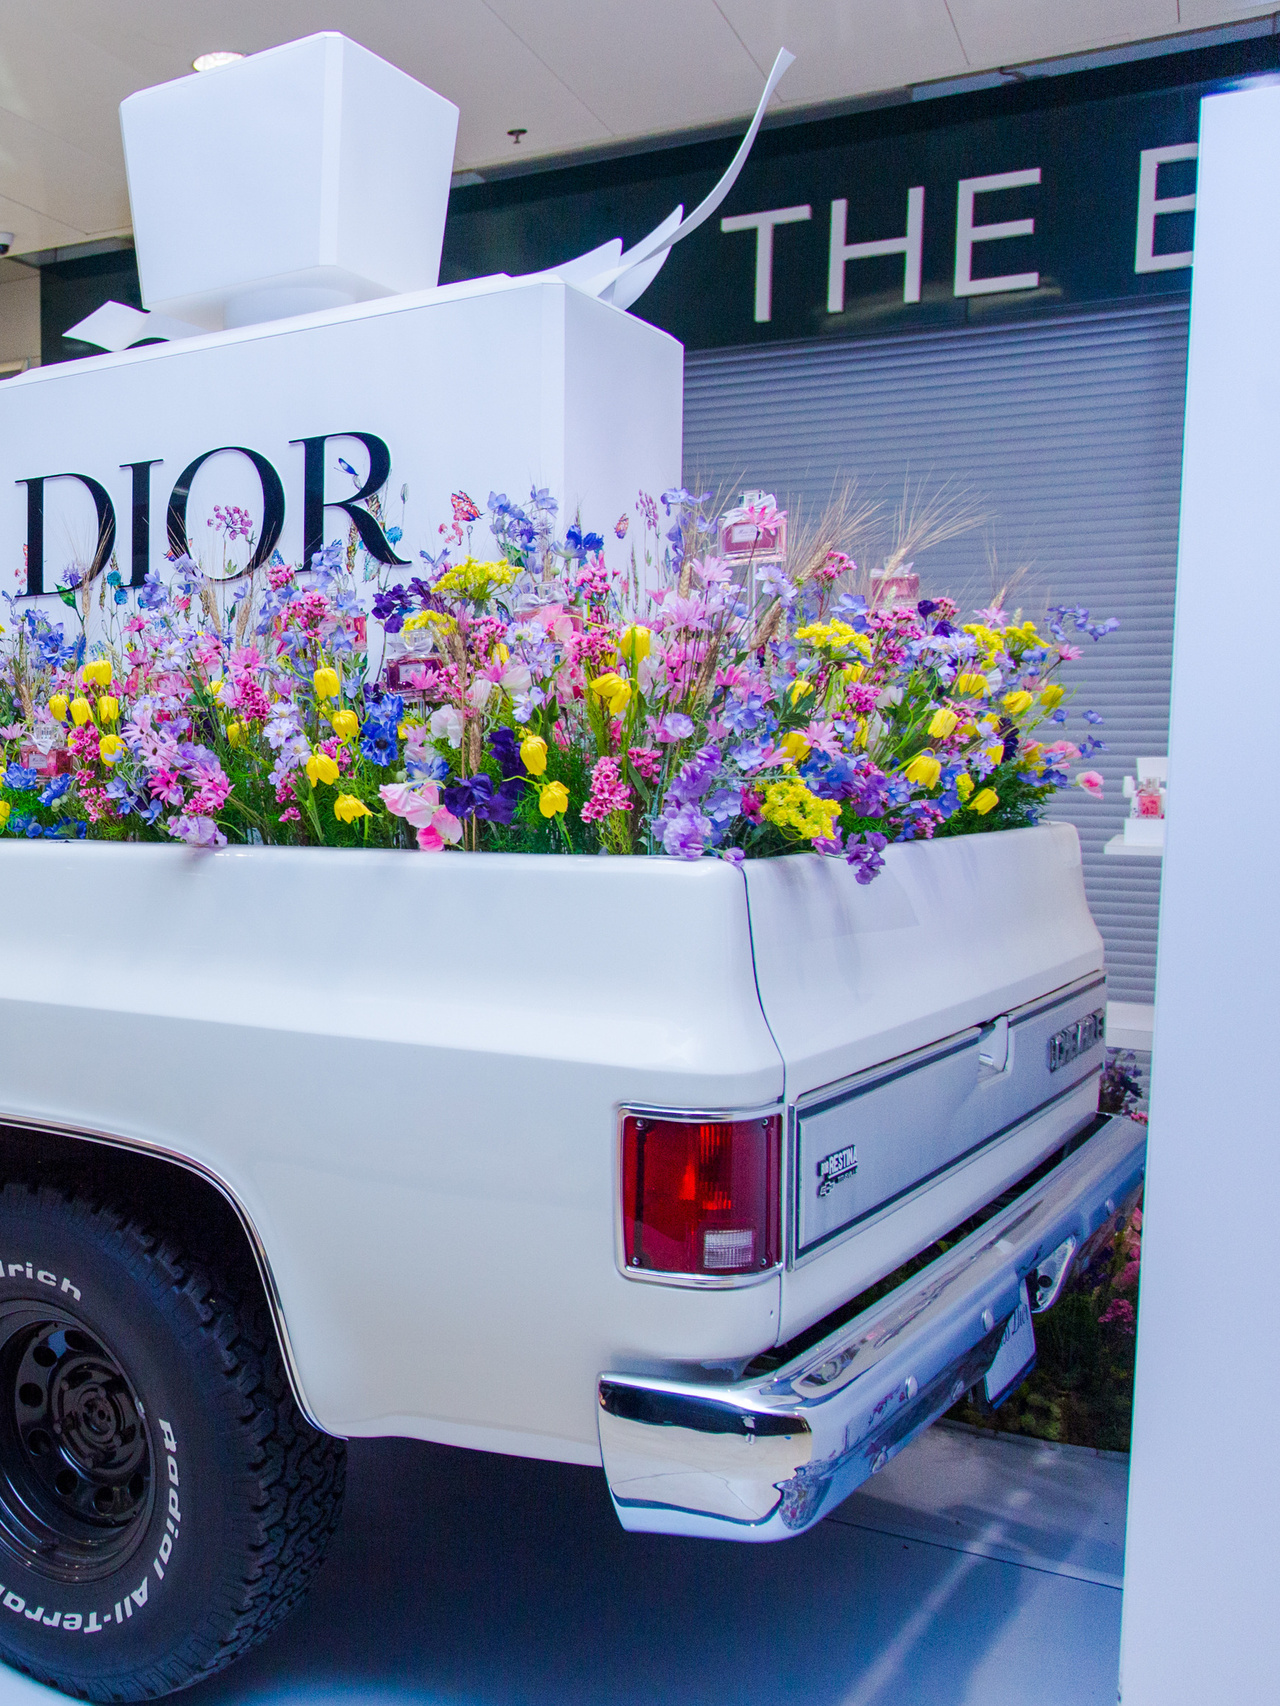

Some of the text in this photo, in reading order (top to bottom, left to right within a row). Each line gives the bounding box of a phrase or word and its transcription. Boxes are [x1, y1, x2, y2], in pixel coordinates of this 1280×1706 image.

[720, 167, 1042, 324] THE
[15, 431, 413, 599] DIOR
[159, 1418, 181, 1580] Radial
